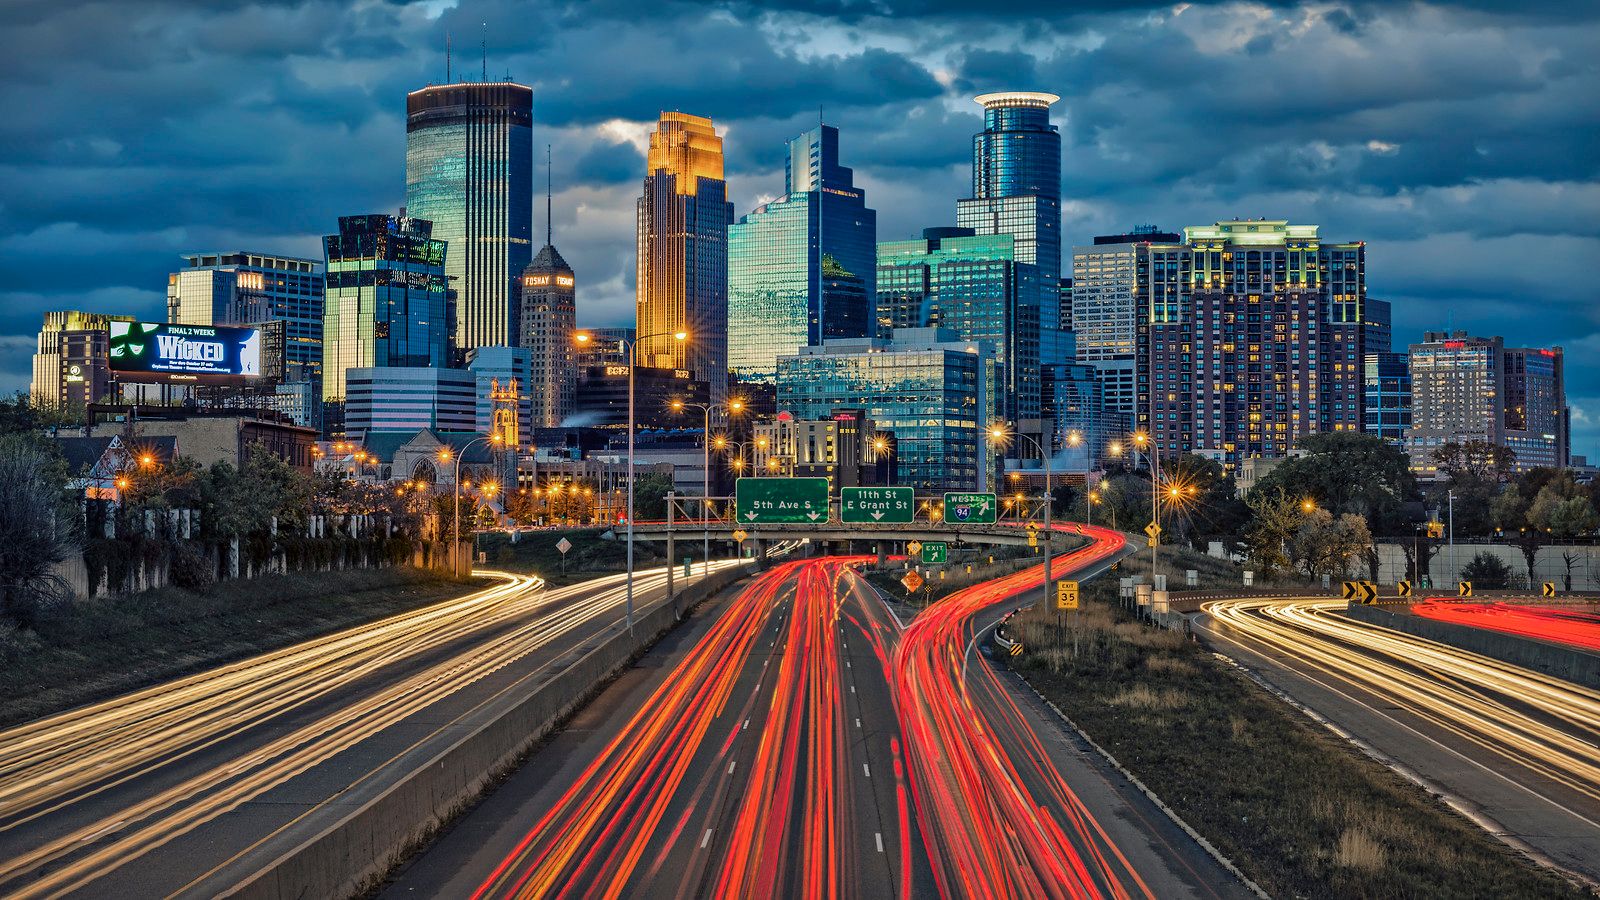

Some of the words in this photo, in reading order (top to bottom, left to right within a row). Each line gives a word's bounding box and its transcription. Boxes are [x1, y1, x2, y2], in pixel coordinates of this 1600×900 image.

[525, 275, 550, 286] FOSHAY
[168, 327, 187, 335] FINAL
[193, 328, 215, 336] WEEKS
[858, 490, 879, 499] 11th
[885, 490, 897, 499] St
[753, 501, 773, 509] 5th
[778, 501, 799, 509] Ave
[804, 501, 811, 509] S
[847, 501, 854, 509] E
[860, 501, 890, 509] Grant
[895, 501, 908, 509] St
[956, 508, 968, 517] 94
[1061, 593, 1075, 602] 35
